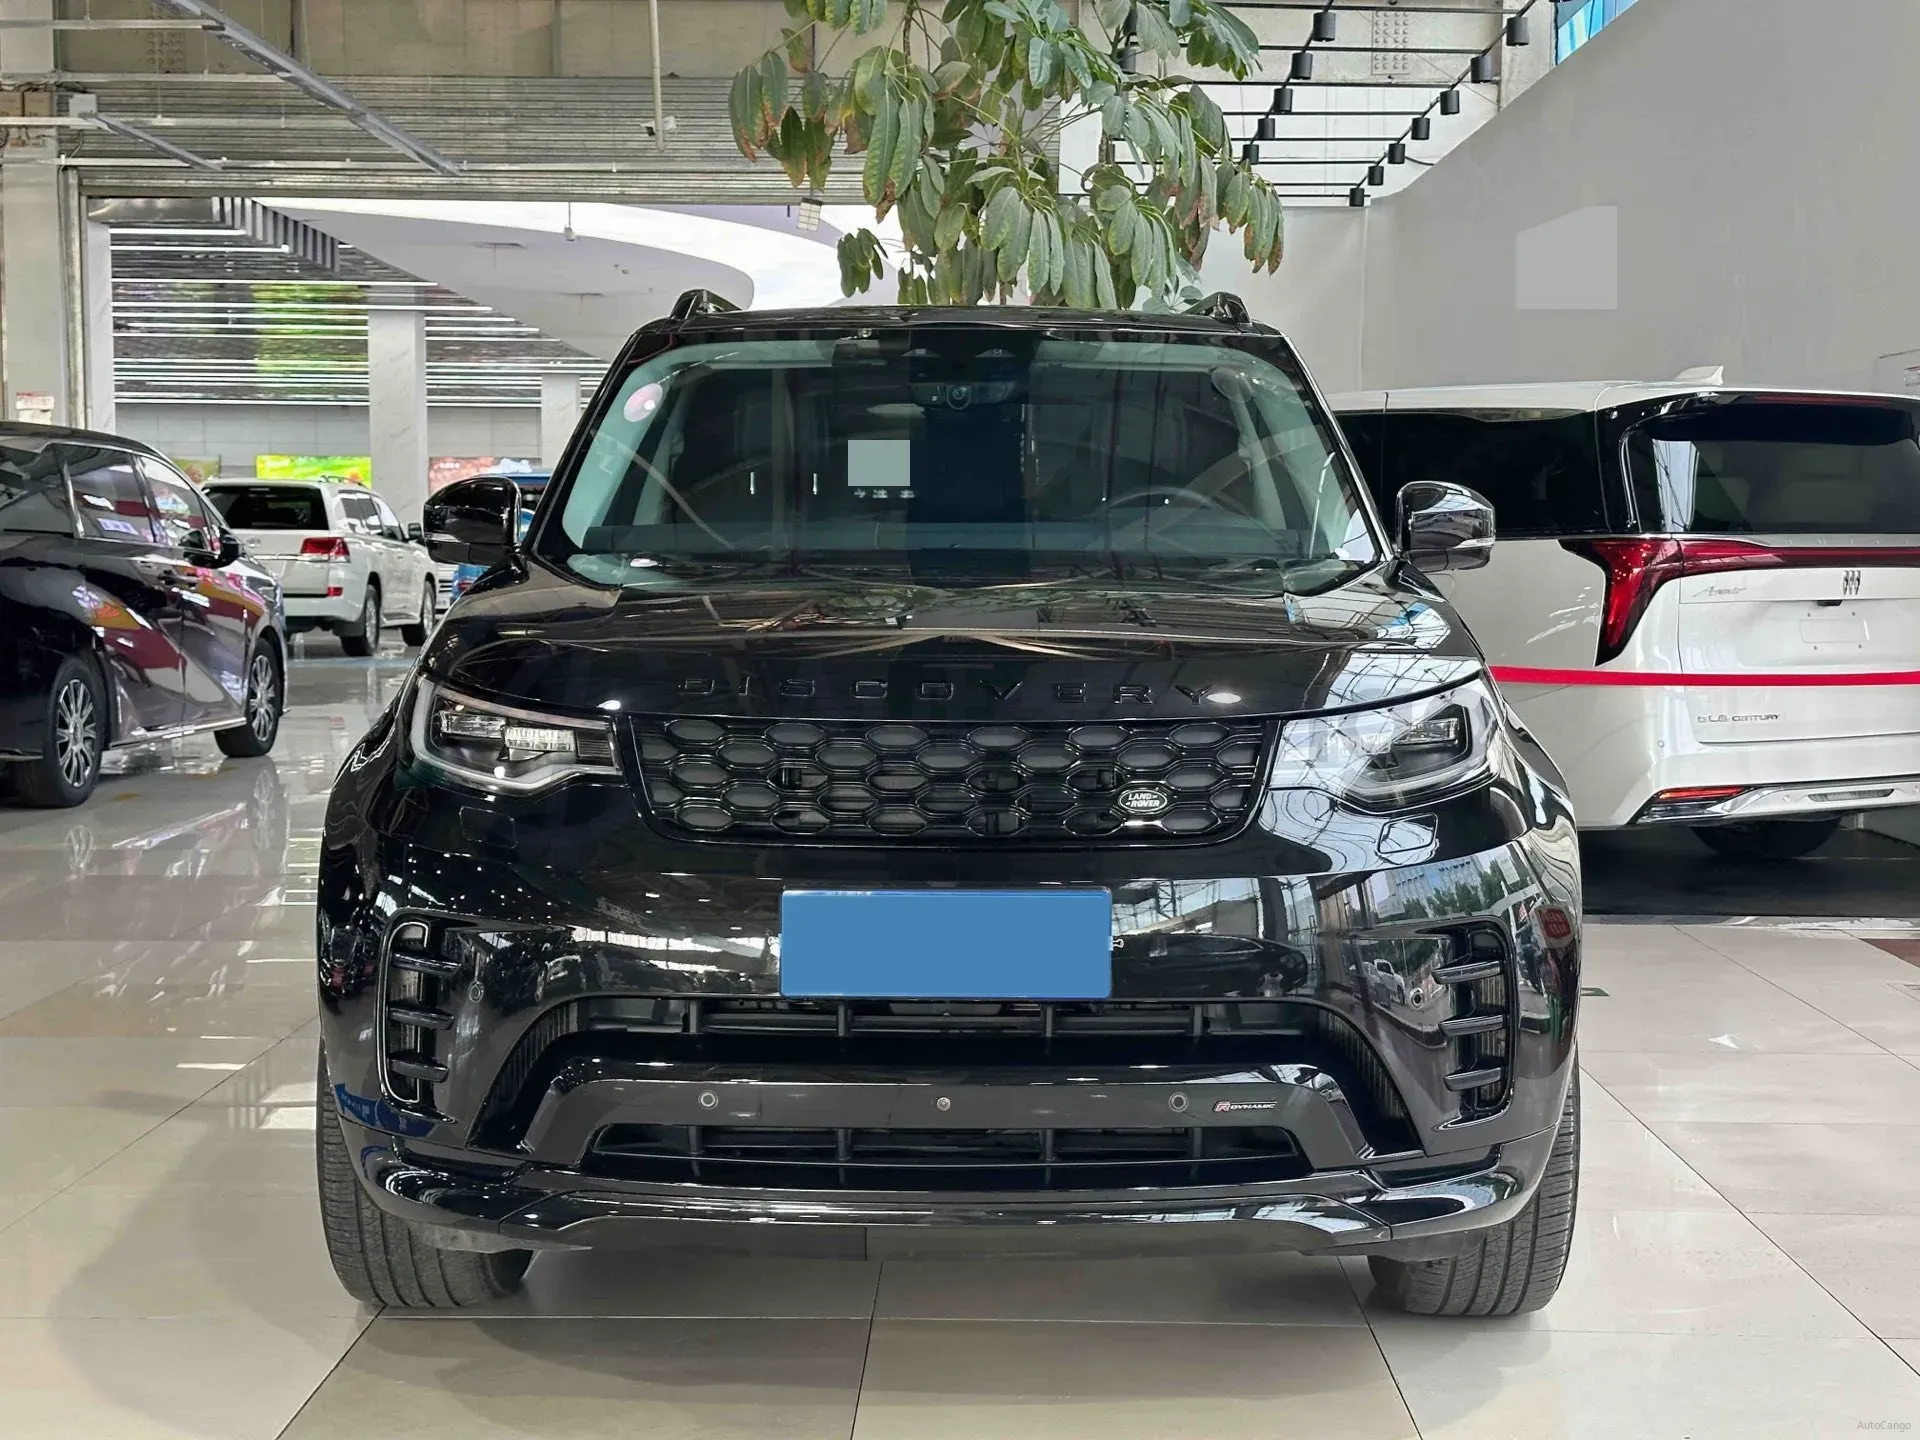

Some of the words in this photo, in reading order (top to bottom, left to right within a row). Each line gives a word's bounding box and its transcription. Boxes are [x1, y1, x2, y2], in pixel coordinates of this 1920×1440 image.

[677, 677, 1214, 706] DISCOVERY
[1128, 792, 1152, 800] LAND
[1130, 799, 1160, 808] ROVER
